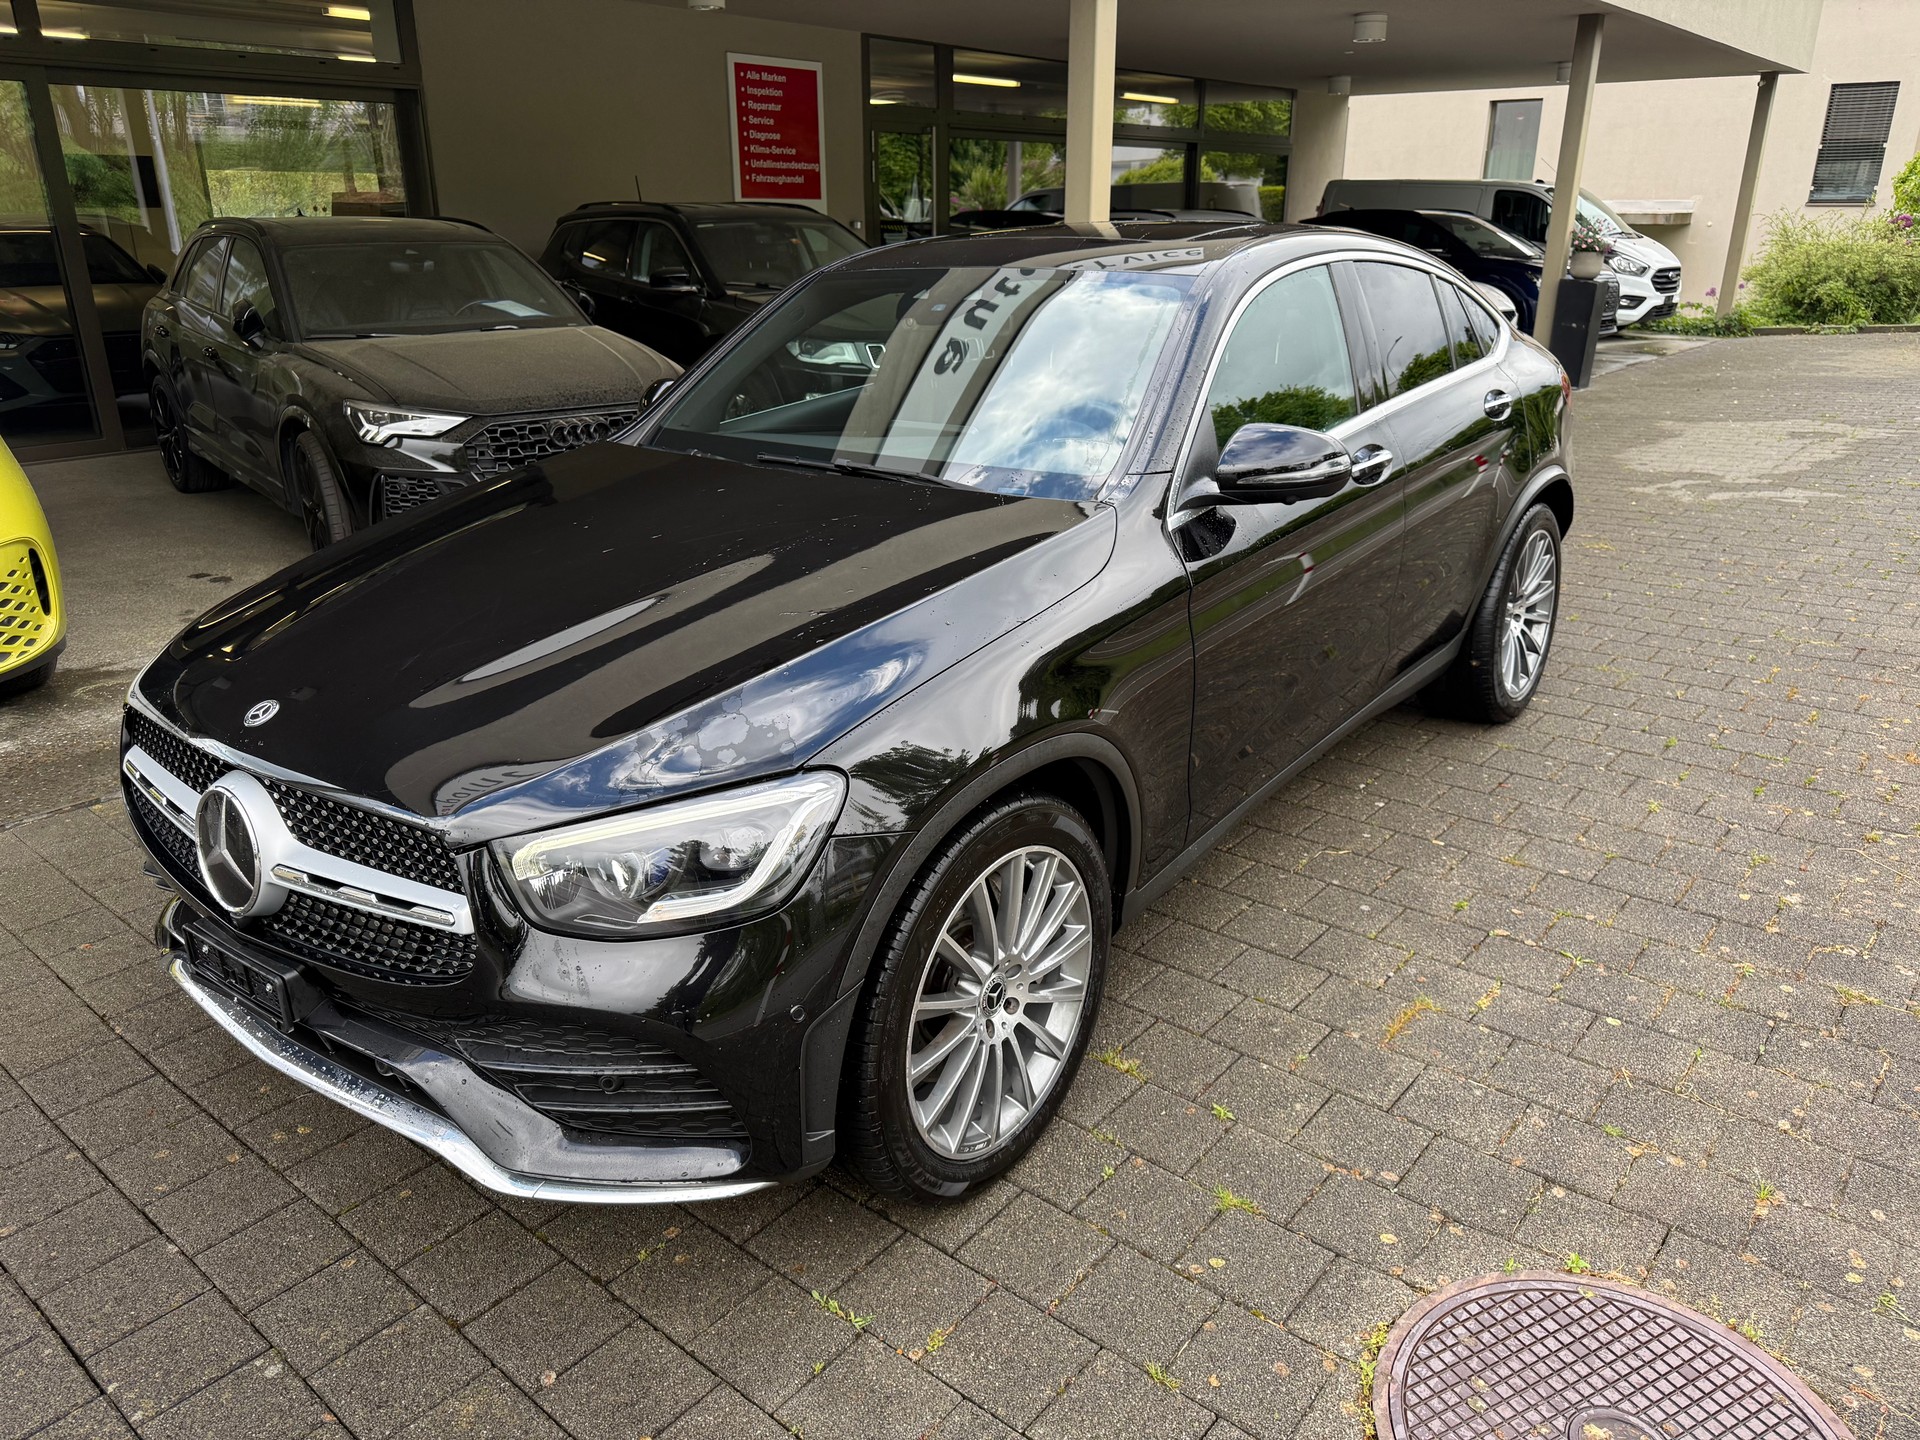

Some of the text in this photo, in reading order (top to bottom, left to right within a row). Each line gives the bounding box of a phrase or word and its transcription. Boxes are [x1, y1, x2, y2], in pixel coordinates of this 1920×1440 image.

[746, 71, 786, 83] Alle Marken
[747, 85, 783, 97] Inspektion
[748, 100, 782, 111] Reparatur
[749, 115, 774, 125] Service
[749, 130, 781, 141] Diagnose
[750, 145, 796, 155] Klima-Service
[750, 159, 820, 171] Unfallinstandsetzung
[751, 173, 804, 184] Fahrzeughandel
